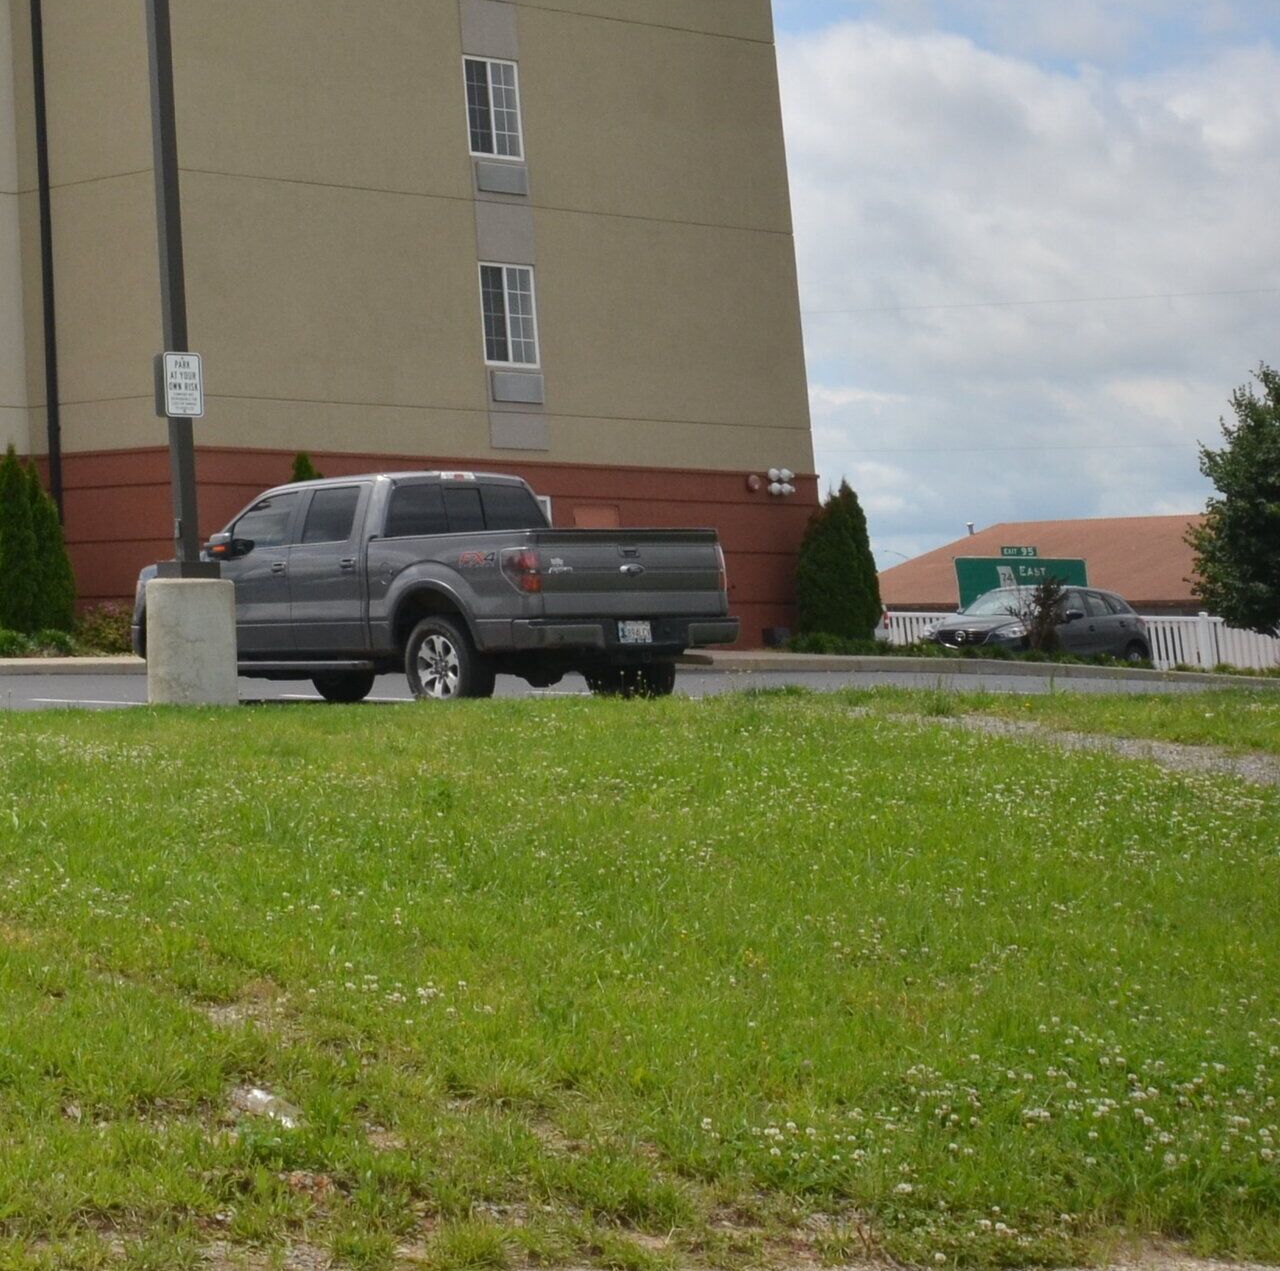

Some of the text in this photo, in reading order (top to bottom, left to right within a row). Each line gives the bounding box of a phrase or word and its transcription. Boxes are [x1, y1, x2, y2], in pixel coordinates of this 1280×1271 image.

[174, 360, 190, 369] PARK
[170, 371, 196, 380] AT YOUR
[169, 382, 198, 391] OWN RISK
[1021, 547, 1034, 556] 95
[458, 551, 496, 564] FX4
[1019, 566, 1046, 576] EAST
[1001, 573, 1013, 582] 74
